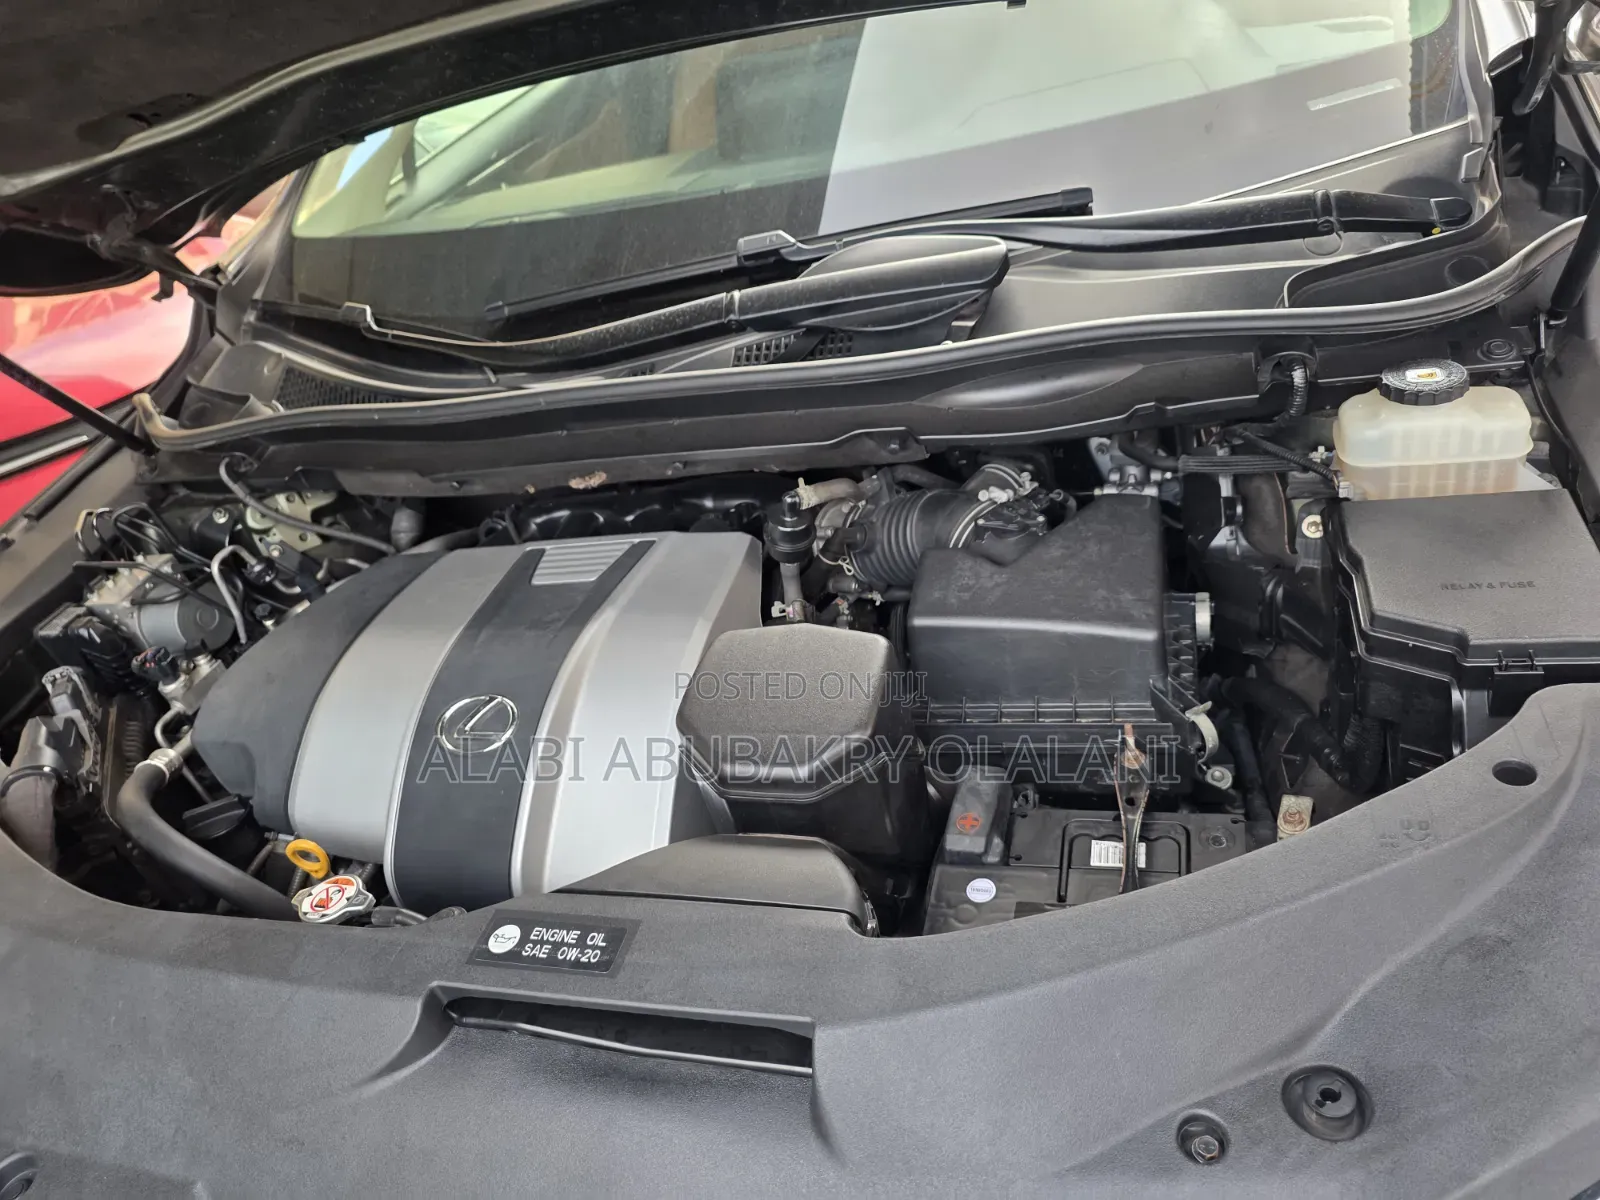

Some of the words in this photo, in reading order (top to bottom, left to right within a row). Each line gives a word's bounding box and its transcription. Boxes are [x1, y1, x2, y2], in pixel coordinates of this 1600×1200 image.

[1441, 581, 1483, 591] RELAY
[1499, 580, 1537, 589] FUSE
[529, 927, 581, 944] ENGINE
[586, 932, 608, 947] OIL
[521, 943, 552, 959] SAE
[556, 946, 601, 963] 0W-20
